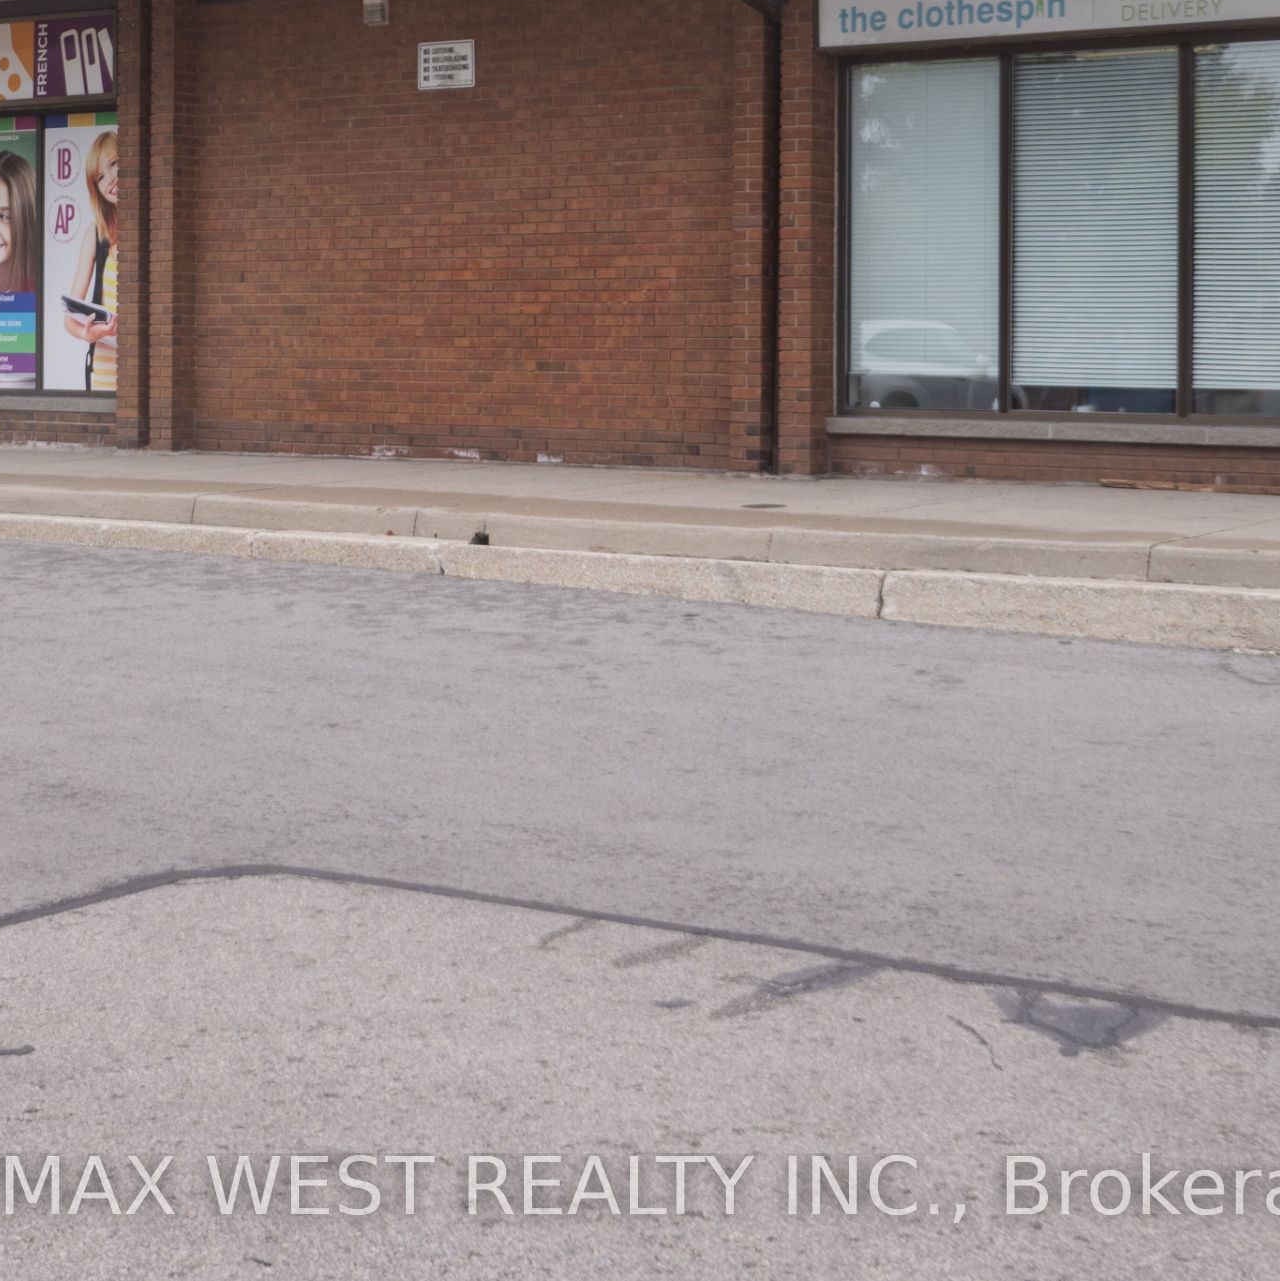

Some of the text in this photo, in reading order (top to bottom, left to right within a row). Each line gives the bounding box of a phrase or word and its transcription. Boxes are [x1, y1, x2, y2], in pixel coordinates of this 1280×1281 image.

[839, 6, 886, 33] the
[1122, 0, 1224, 21] DELIVERY
[37, 23, 48, 96] FRENCH
[58, 148, 71, 180] IB
[54, 204, 75, 234] AP
[0, 334, 18, 342] based
